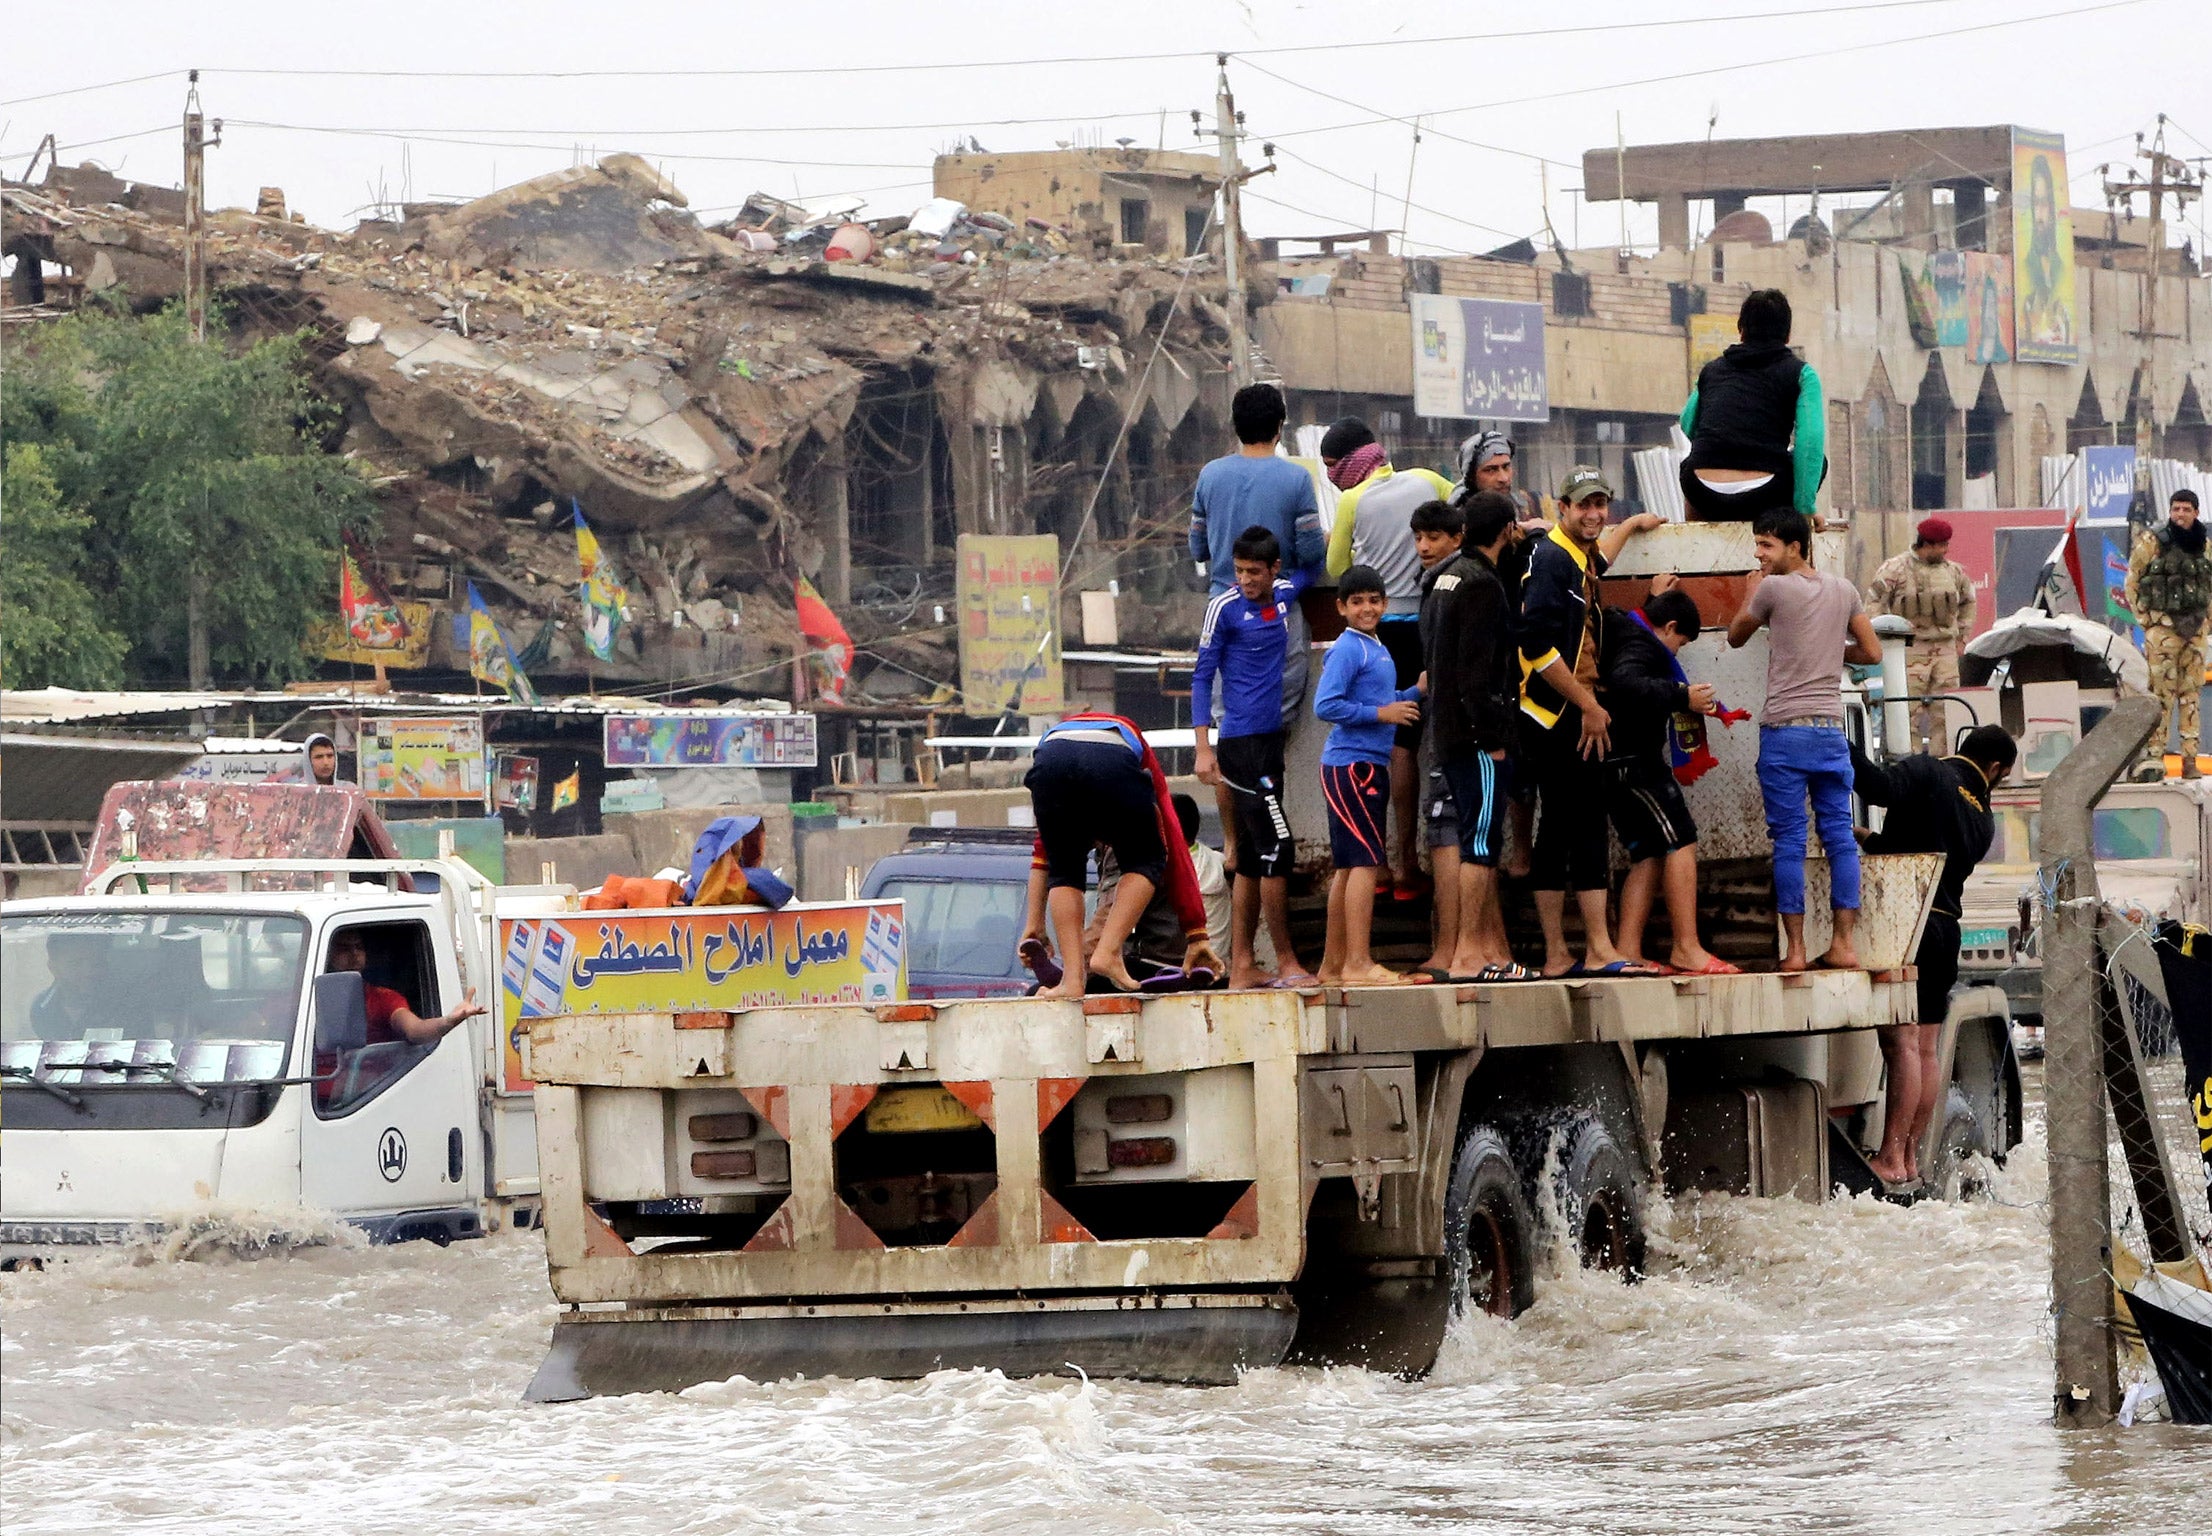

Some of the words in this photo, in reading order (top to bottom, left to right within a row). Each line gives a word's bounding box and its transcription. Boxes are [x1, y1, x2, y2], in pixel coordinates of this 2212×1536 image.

[571, 919, 694, 991] المصطفى
[702, 917, 775, 985] املاح
[785, 916, 850, 979] معمل
